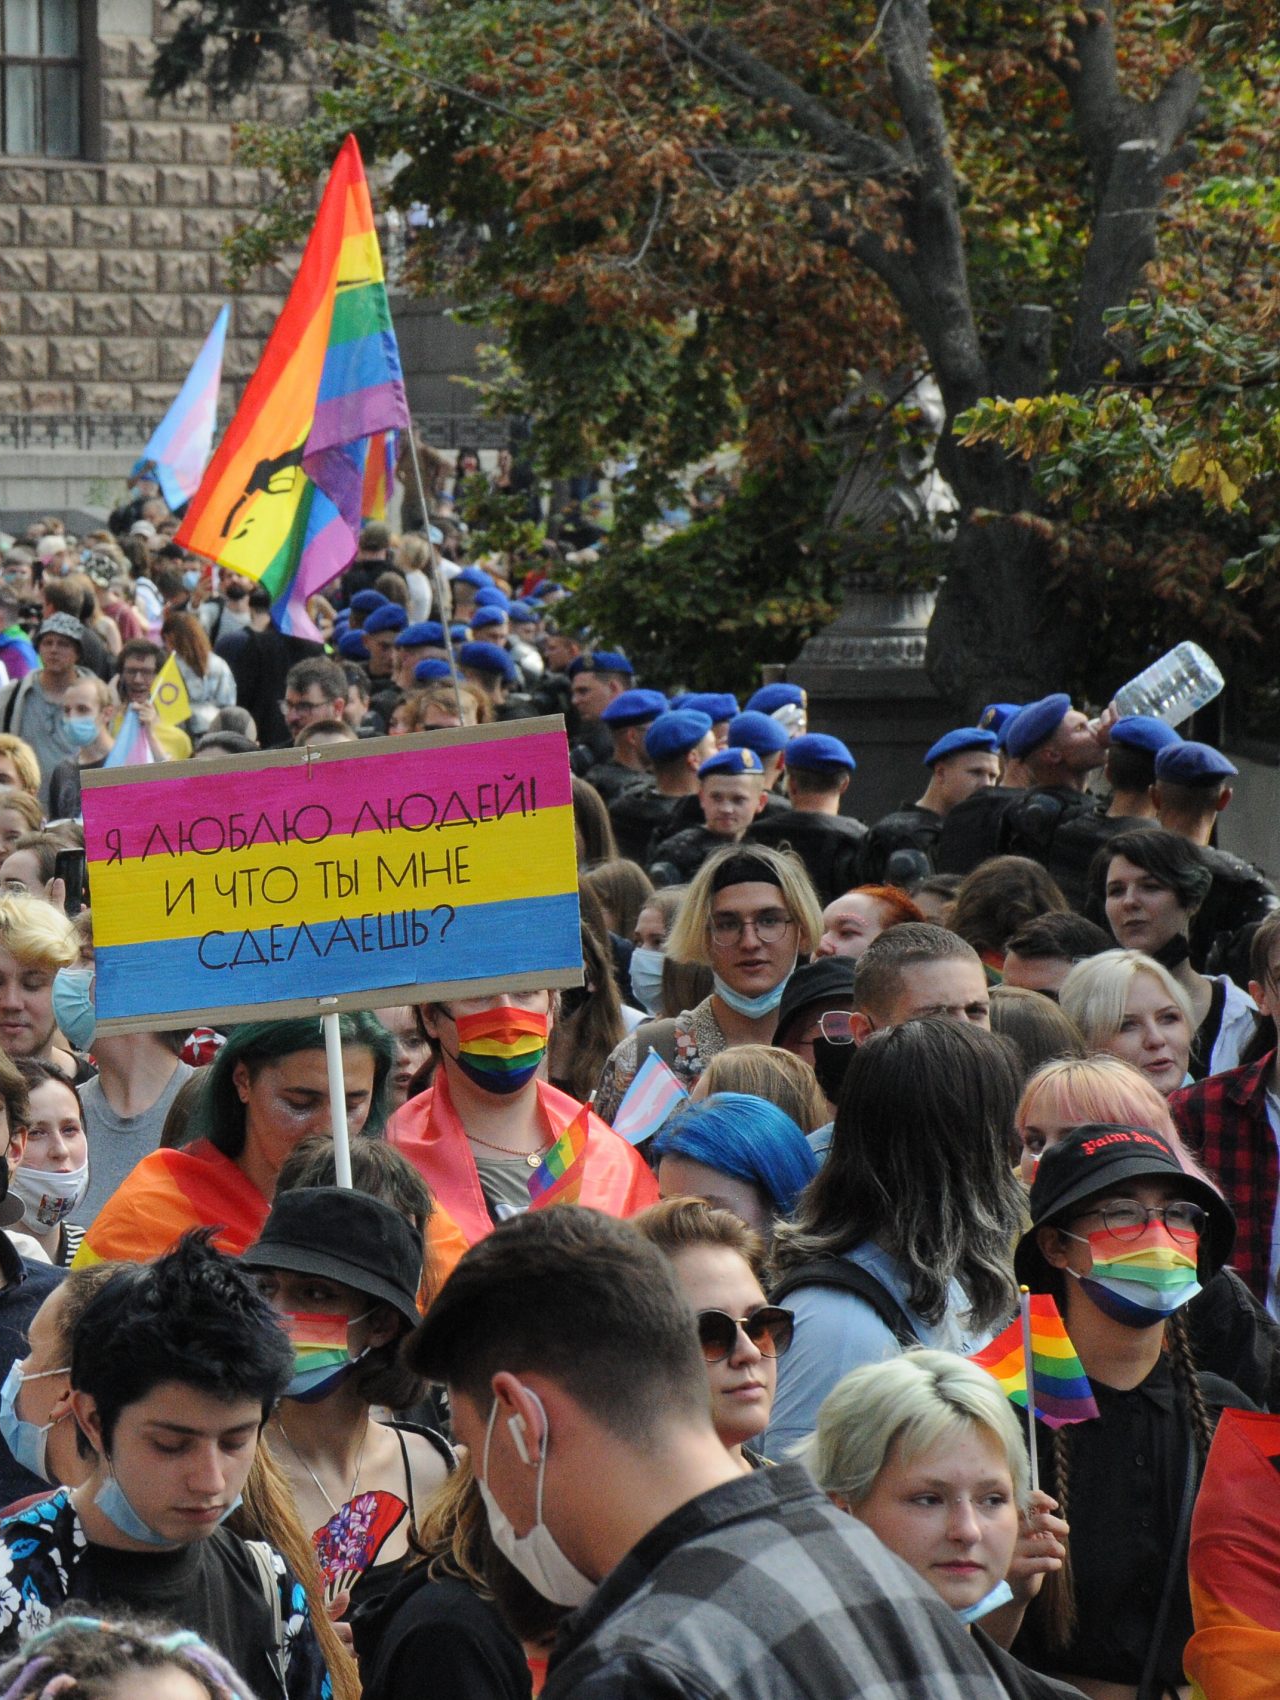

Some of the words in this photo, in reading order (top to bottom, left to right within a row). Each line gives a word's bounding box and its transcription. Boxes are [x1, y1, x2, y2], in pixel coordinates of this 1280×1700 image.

[106, 829, 123, 866] Я
[142, 805, 332, 862] ЛЮБЛЮ
[351, 773, 537, 838] ЛЮДЕЙ!
[165, 878, 195, 917] И
[215, 865, 298, 908] ЧТО
[314, 859, 359, 899] ТЫ
[377, 845, 471, 893] МНЕ
[198, 904, 455, 970] СДЕЛАЕШЬ?
